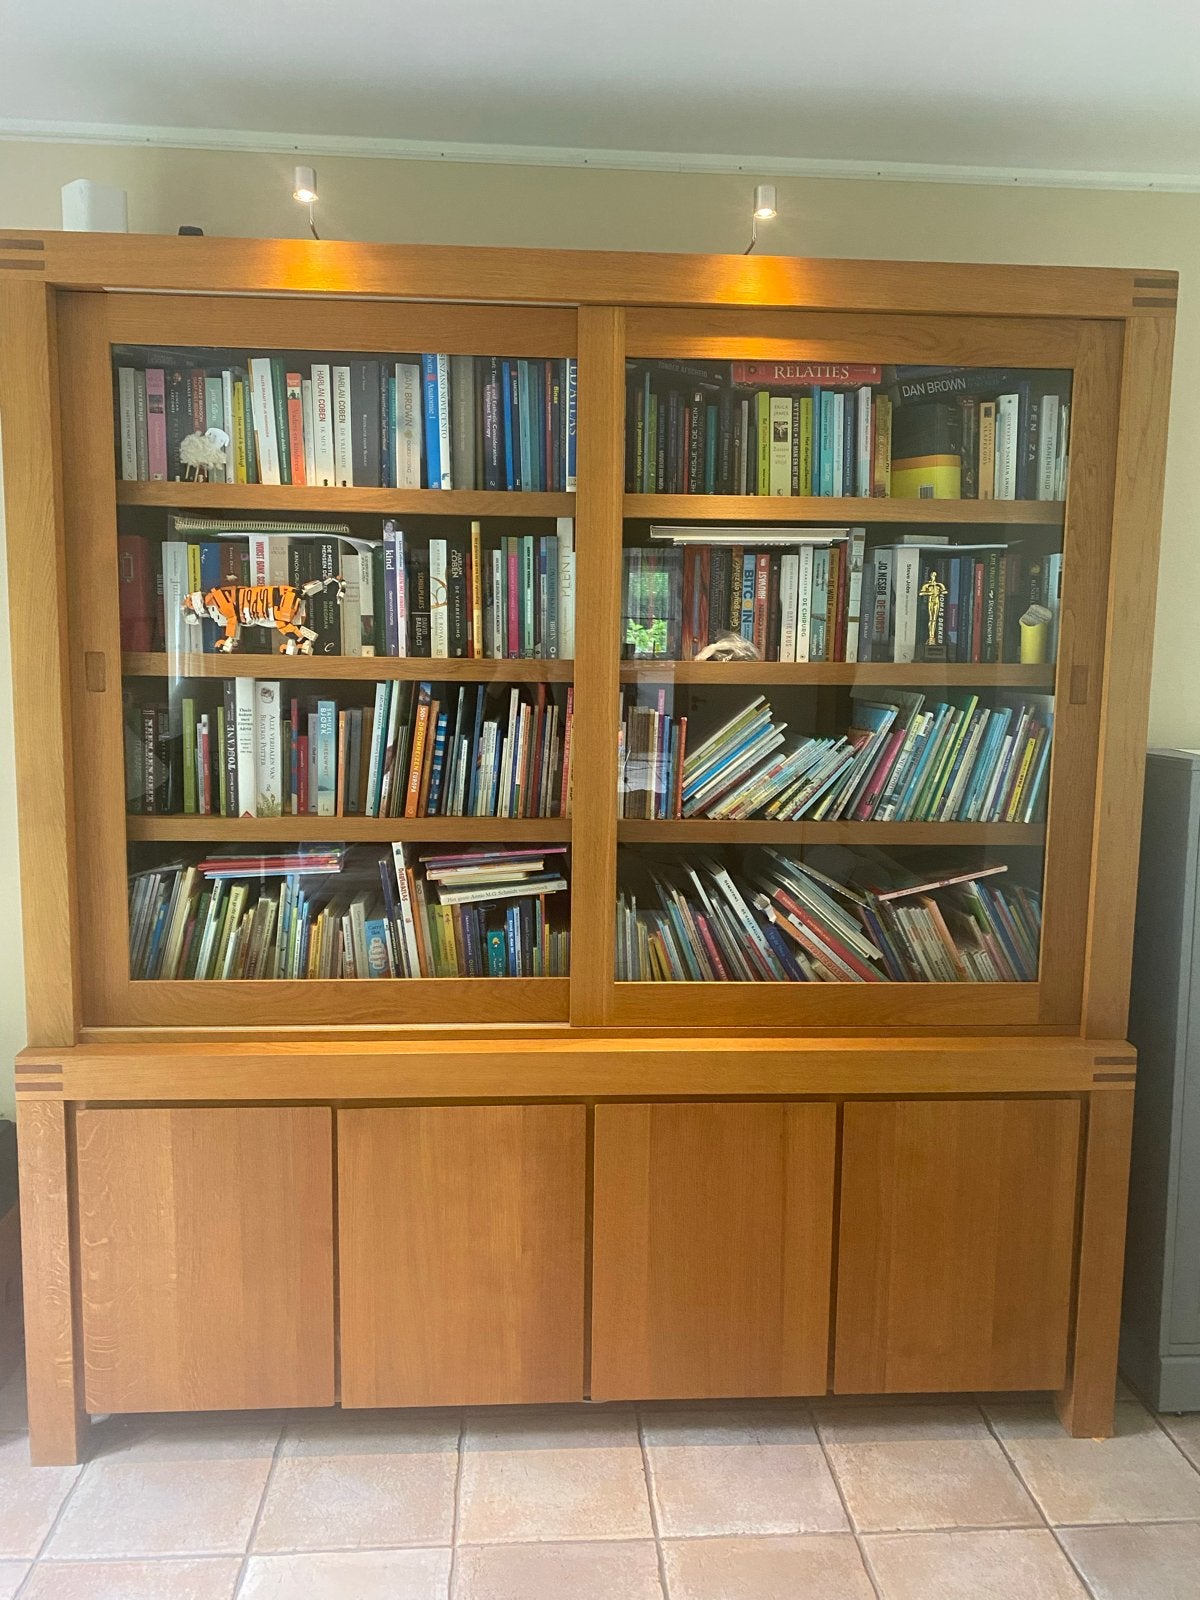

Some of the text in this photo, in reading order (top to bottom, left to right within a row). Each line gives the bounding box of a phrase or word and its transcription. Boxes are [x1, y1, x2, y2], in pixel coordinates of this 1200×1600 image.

[317, 370, 325, 397] HARLAN
[404, 370, 412, 390] DAN
[773, 365, 849, 380] RELATIES
[901, 378, 967, 397] DAN BROWN
[318, 398, 326, 423] COBEN
[338, 400, 346, 424] COBEN
[404, 392, 413, 427] BROWN
[691, 441, 698, 449] IN
[692, 429, 698, 440] DE
[256, 541, 265, 574] WORST BANK
[327, 544, 332, 554] DE
[385, 549, 394, 570] kind
[559, 544, 571, 598] PLENTY
[417, 571, 425, 609] SCHUILPLAATS
[742, 569, 754, 623] BITCOIN
[758, 570, 767, 599] HOUVAST
[876, 561, 887, 634] JO NESBØ DE DORST
[802, 597, 808, 606] DE
[226, 724, 236, 770] TOSCANE
[409, 707, 427, 793] 500+ DROOMREIZEN EUROPA
